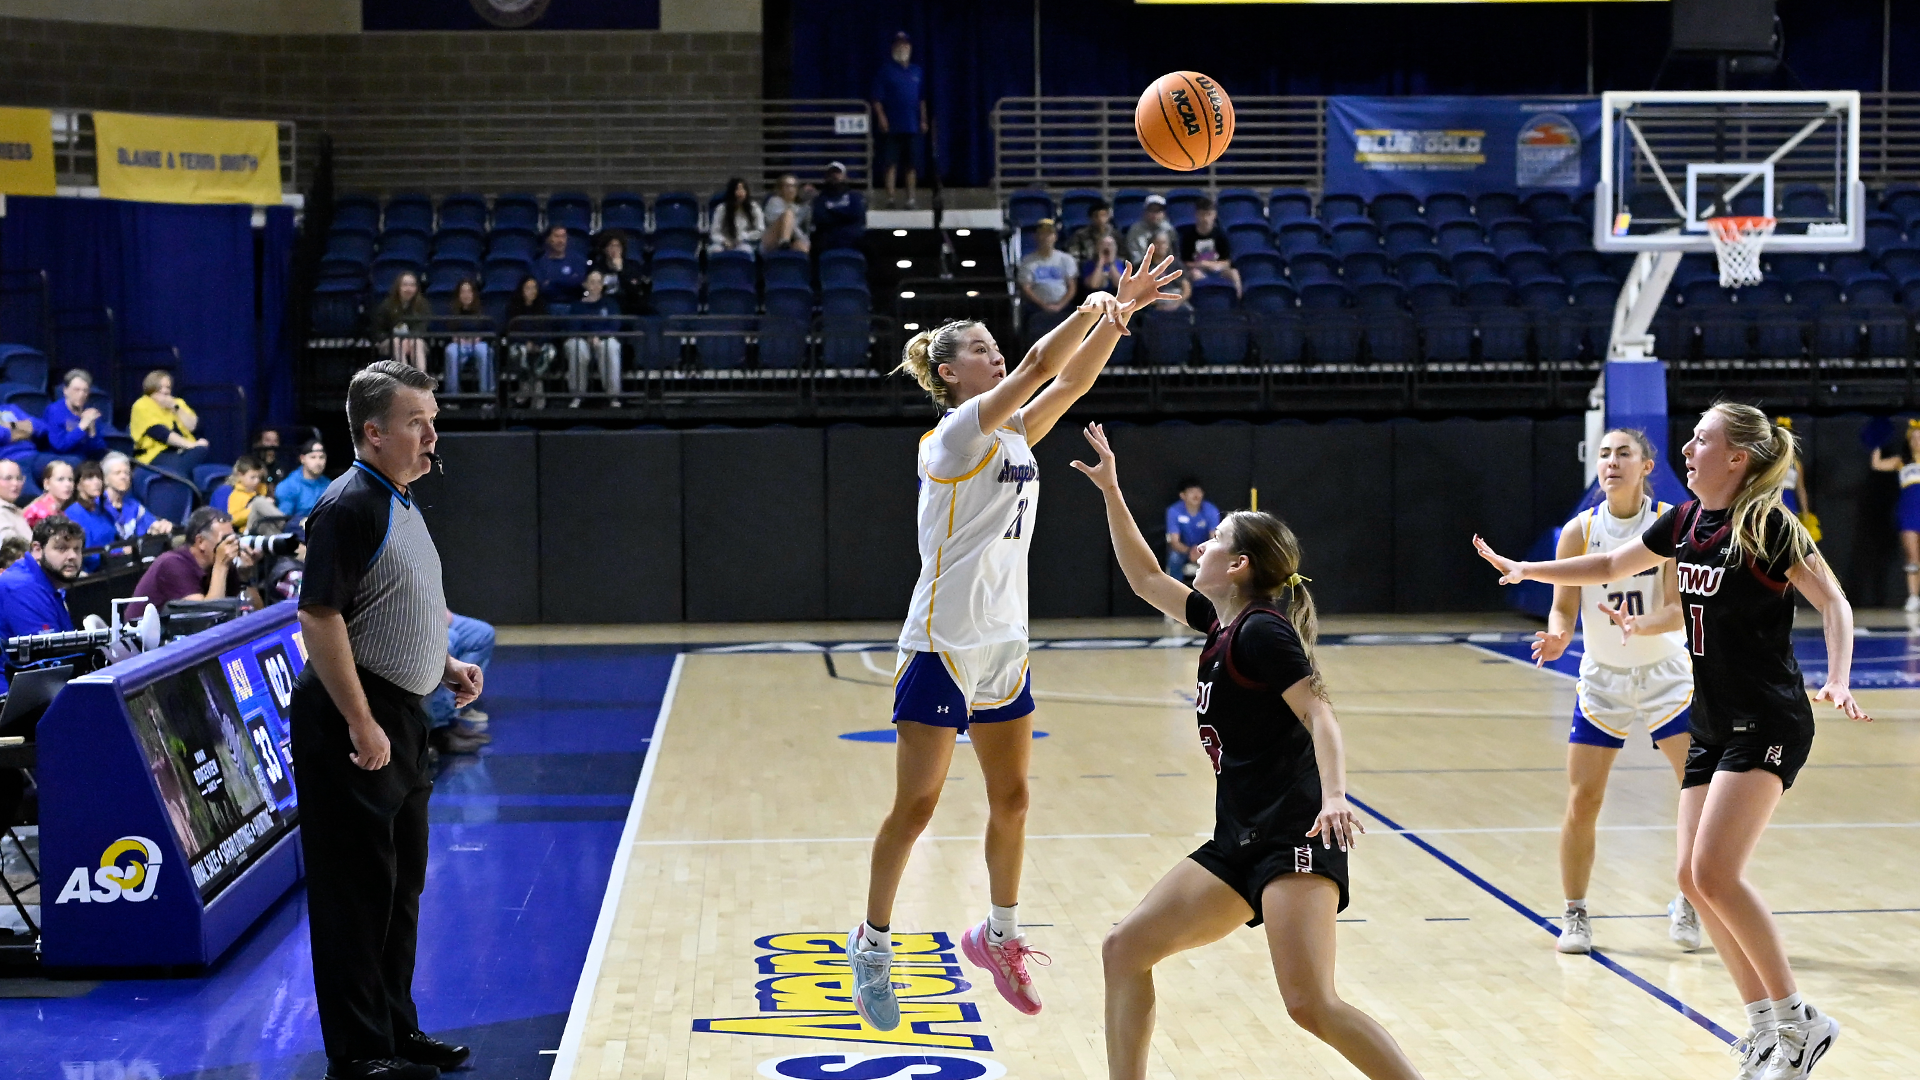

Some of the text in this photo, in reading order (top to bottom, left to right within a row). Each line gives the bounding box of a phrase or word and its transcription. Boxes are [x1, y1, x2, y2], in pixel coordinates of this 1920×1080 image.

[1170, 89, 1201, 136] NCAA
[1196, 76, 1224, 136] Wilson
[1003, 497, 1029, 540] 21
[1677, 562, 1725, 597] TWU
[1607, 591, 1645, 626] 20
[1690, 604, 1705, 657] 1
[252, 726, 283, 784] 33
[692, 931, 994, 1052] Arena
